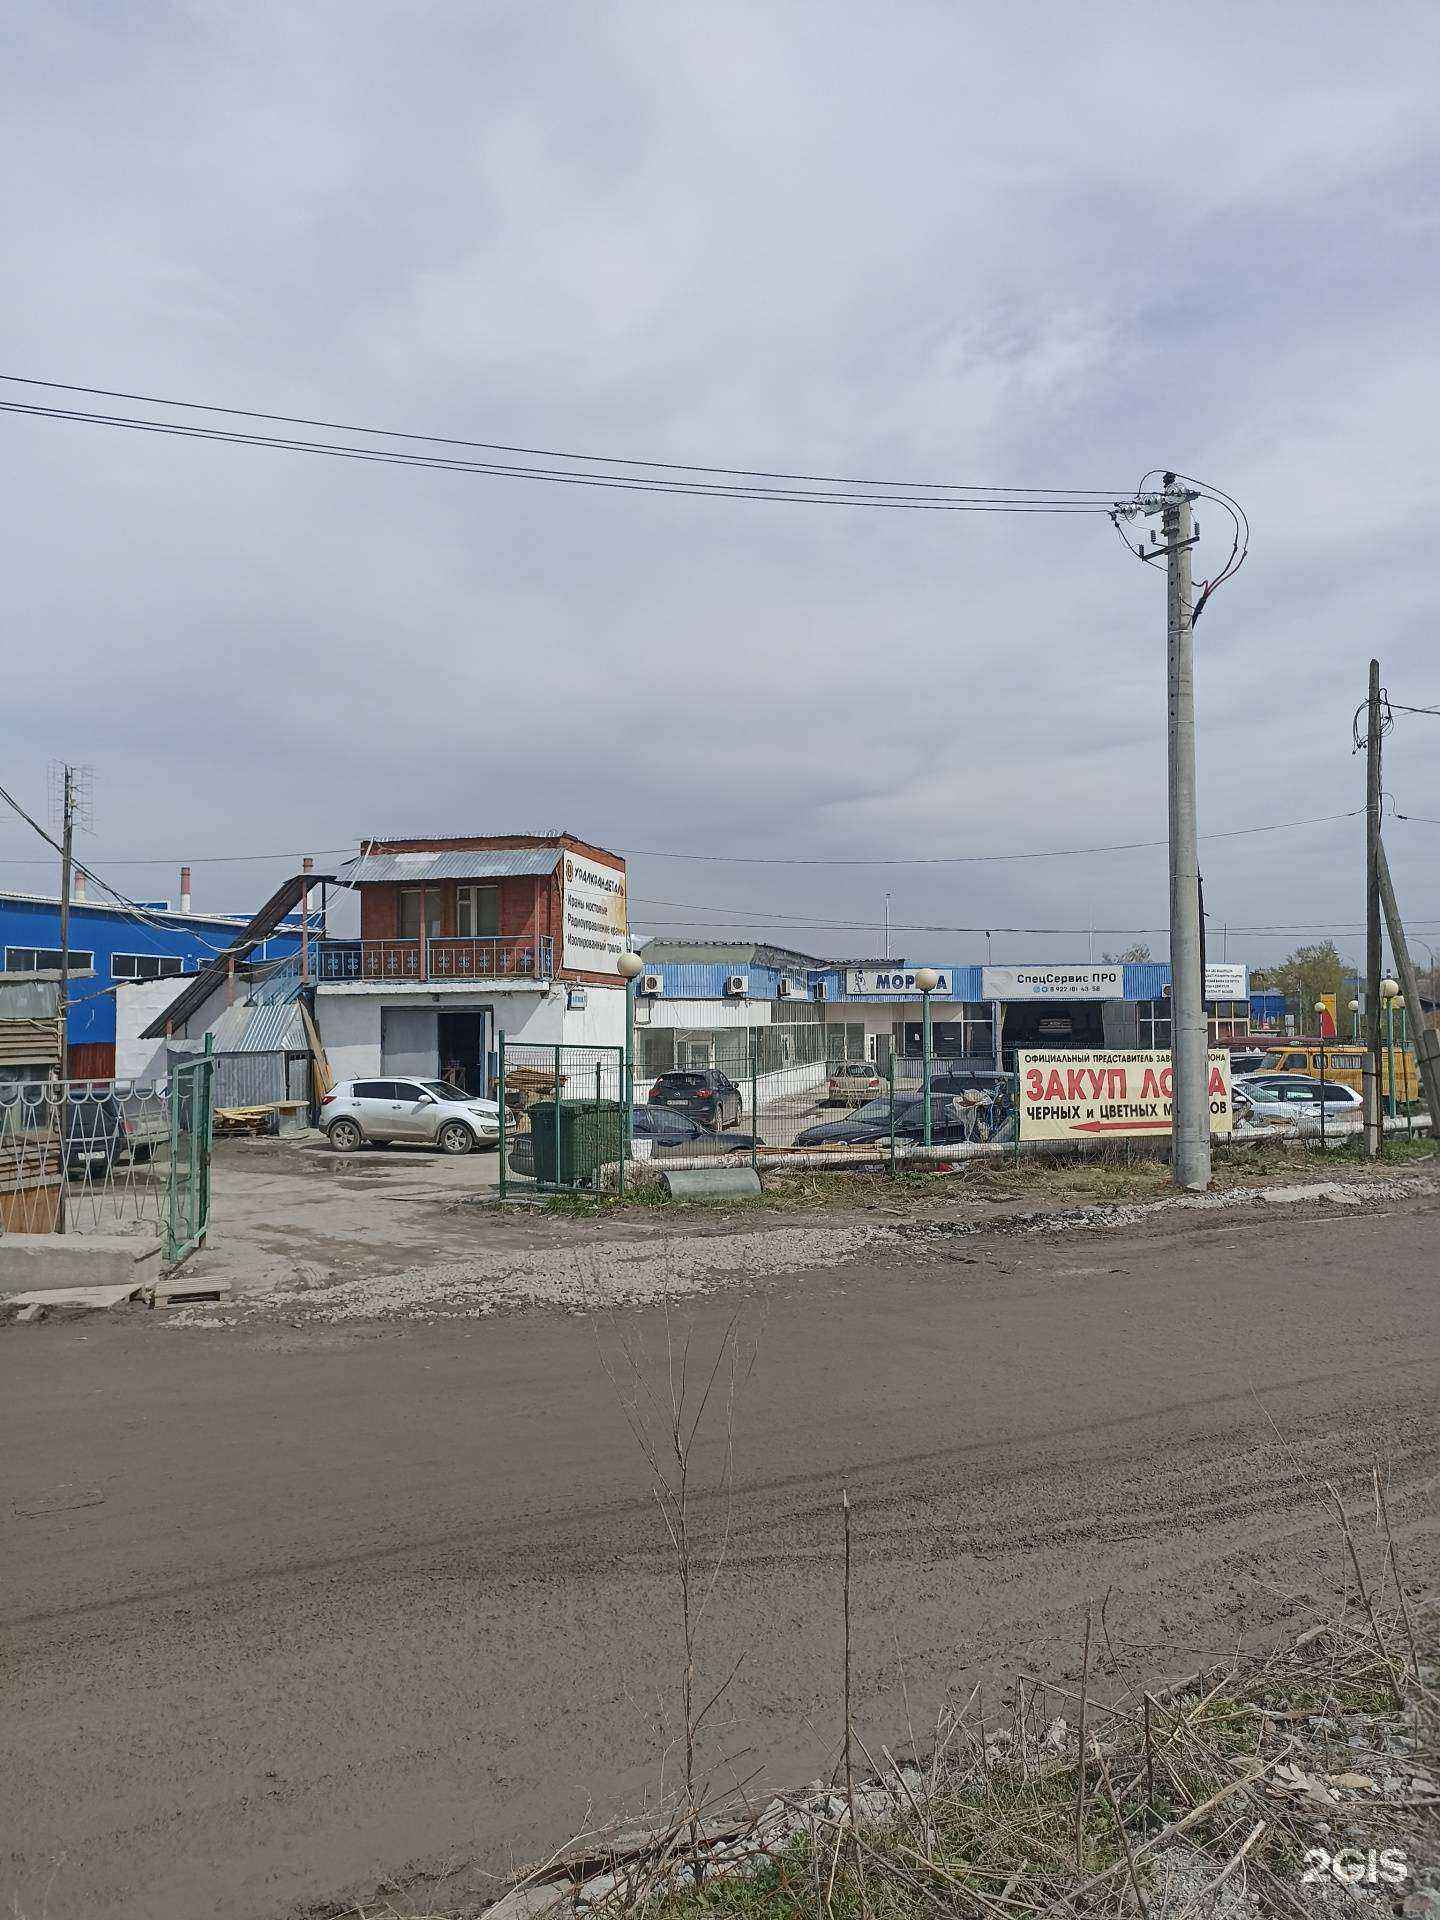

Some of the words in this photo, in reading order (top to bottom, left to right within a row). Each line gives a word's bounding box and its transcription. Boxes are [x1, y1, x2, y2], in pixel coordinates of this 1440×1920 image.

[1017, 973, 1089, 984] СпецСервис
[1092, 973, 1117, 983] ПРО
[1024, 1053, 1090, 1063] ОФИЦИАЛЬНЫЙ
[1093, 1053, 1154, 1063] ПРЕДСТАВИТЕЛЬ
[1026, 1068, 1127, 1101] ЗАКУП
[1140, 1067, 1227, 1099] ЛОА
[1026, 1105, 1081, 1120] ЧЕРНЫХ
[1086, 1109, 1094, 1119] и
[1100, 1104, 1158, 1120] ЦВЕТНЫХ
